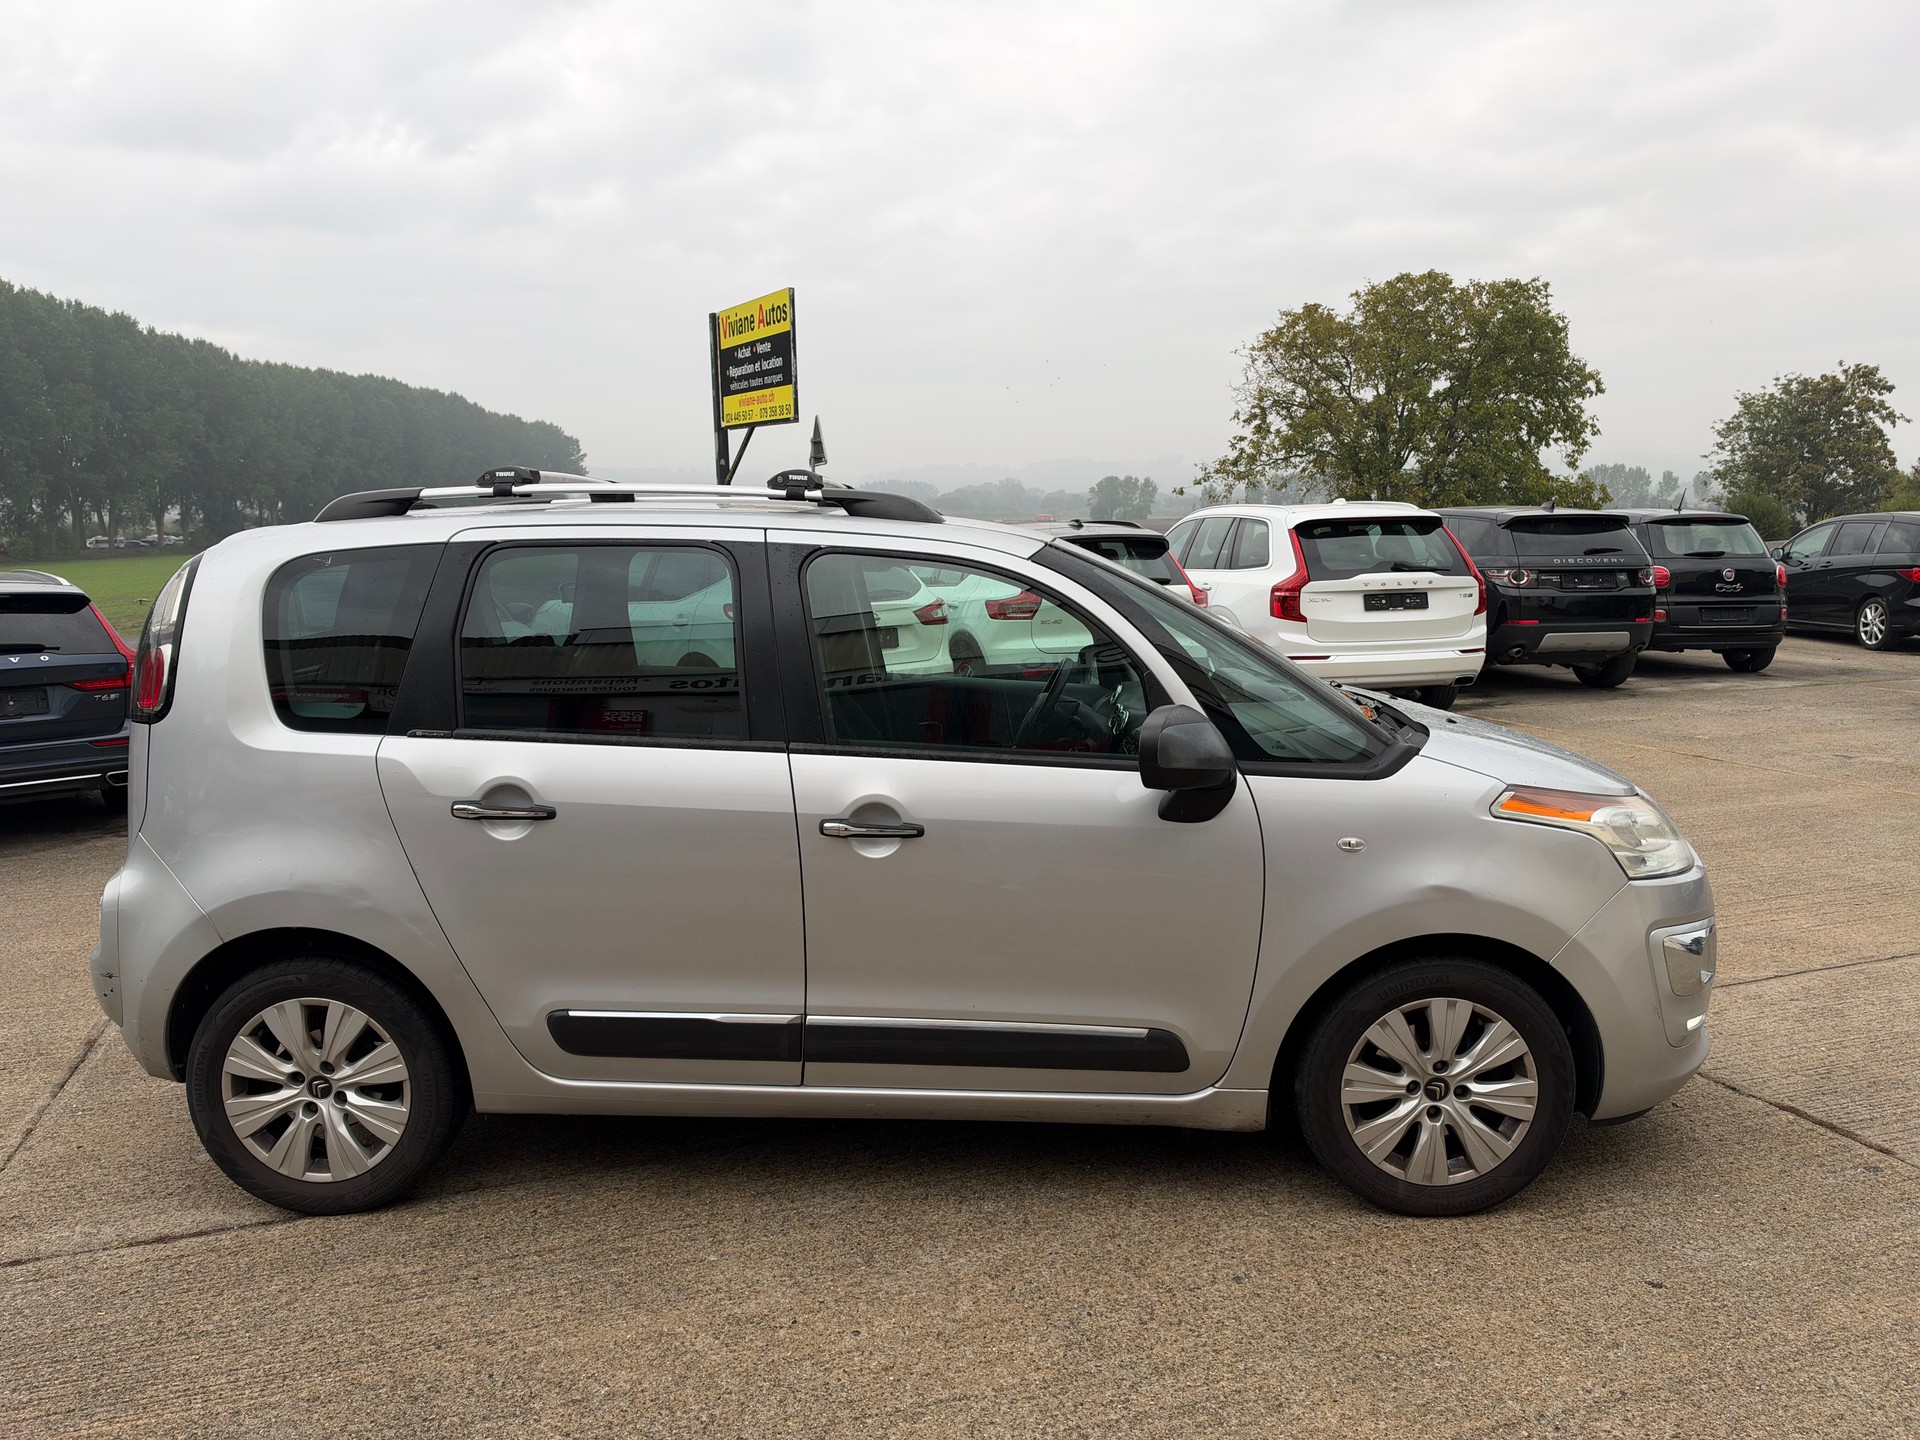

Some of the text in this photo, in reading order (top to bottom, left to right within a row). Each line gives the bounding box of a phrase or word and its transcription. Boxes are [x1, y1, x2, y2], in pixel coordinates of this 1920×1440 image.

[721, 303, 788, 340] Viviane Autos
[737, 341, 772, 359] Achat Vente
[729, 355, 783, 379] Réparation et location
[749, 377, 763, 387] toutes
[764, 373, 783, 385] marques
[725, 413, 733, 424] 024
[748, 409, 753, 421] 57
[759, 407, 768, 418] 079
[769, 406, 778, 417] 358
[778, 405, 785, 416] 38
[786, 404, 792, 415] 50
[1363, 579, 1434, 587] VOLVO
[1377, 974, 1456, 1001] UNIROYAL
[193, 1044, 210, 1113] UNIROYAL
[418, 1073, 434, 1142] UNIROYAL
[1433, 1186, 1507, 1214] UNIROYAL
